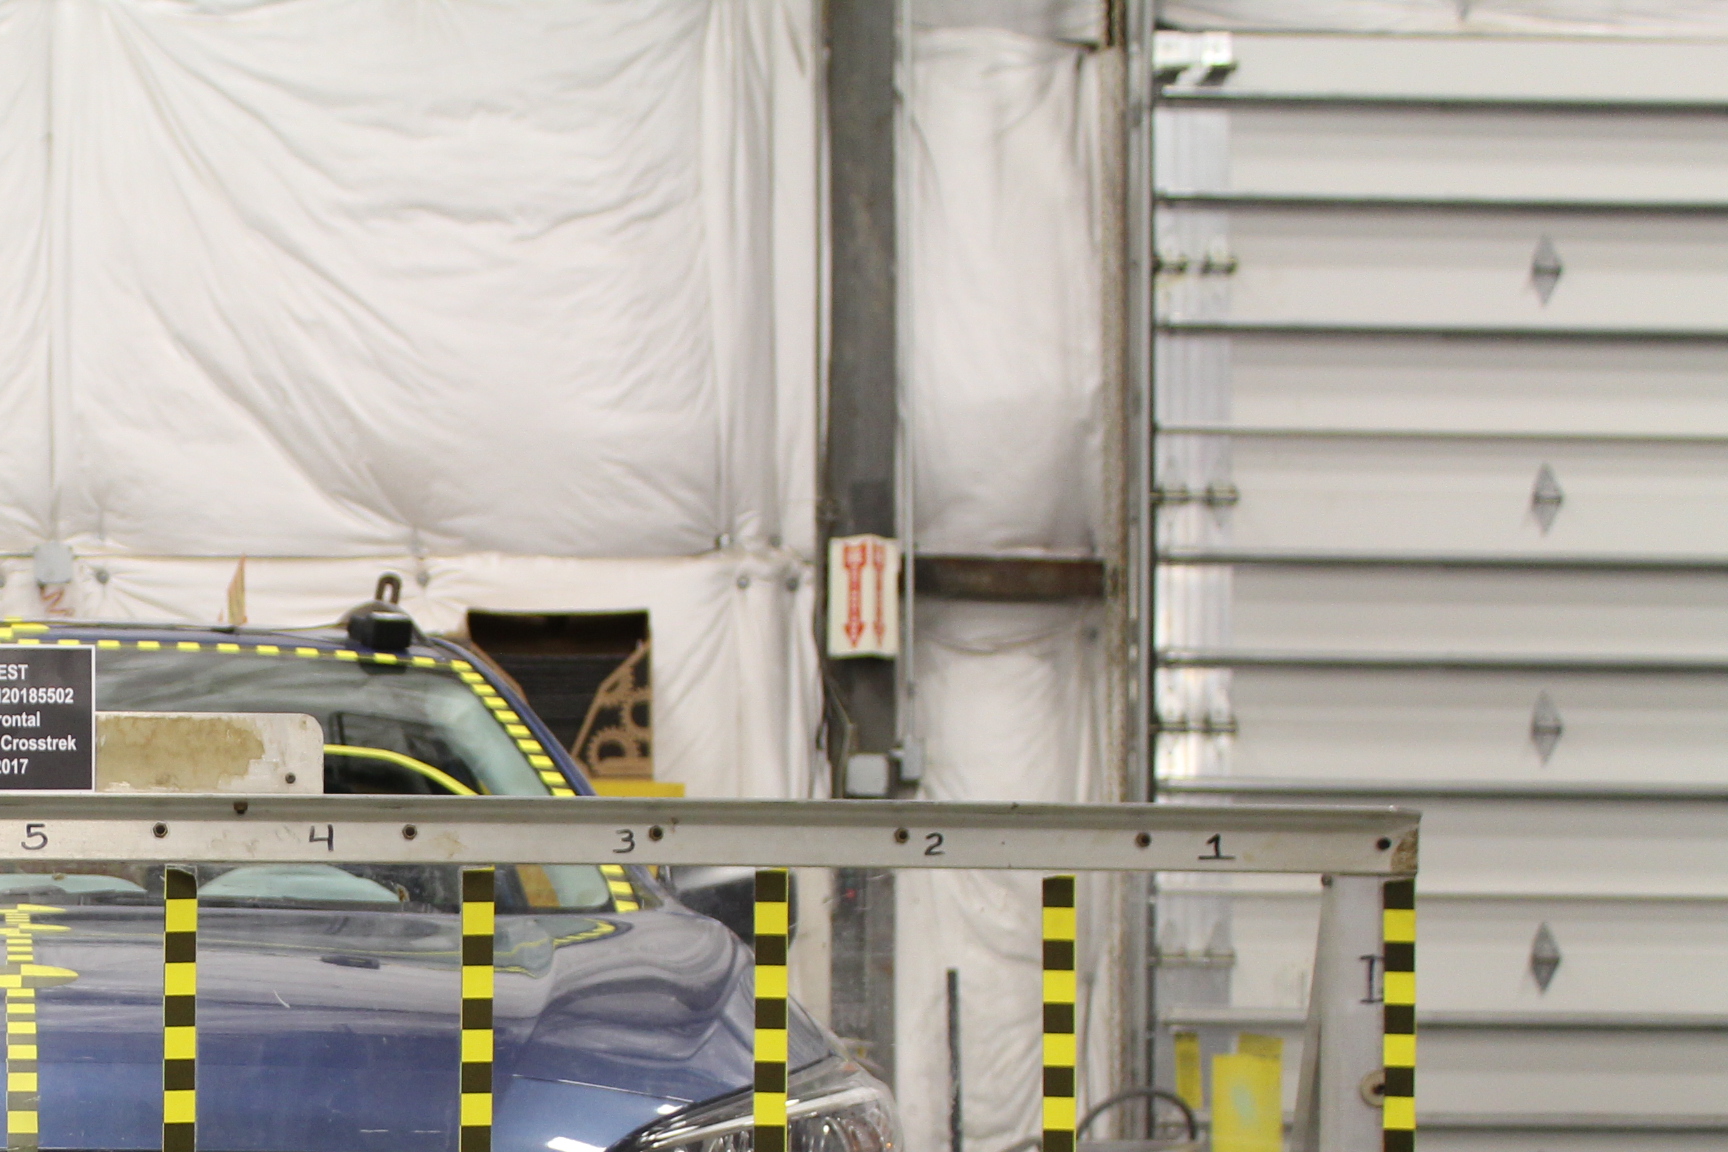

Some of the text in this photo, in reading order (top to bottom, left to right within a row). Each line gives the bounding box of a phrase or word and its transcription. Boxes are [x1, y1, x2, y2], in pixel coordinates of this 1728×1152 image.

[0, 734, 77, 751] Crosstrek
[20, 823, 49, 851] 5
[308, 823, 334, 852] 4
[612, 828, 636, 854] 3
[924, 832, 944, 856] 2
[1198, 833, 1234, 861] 1
